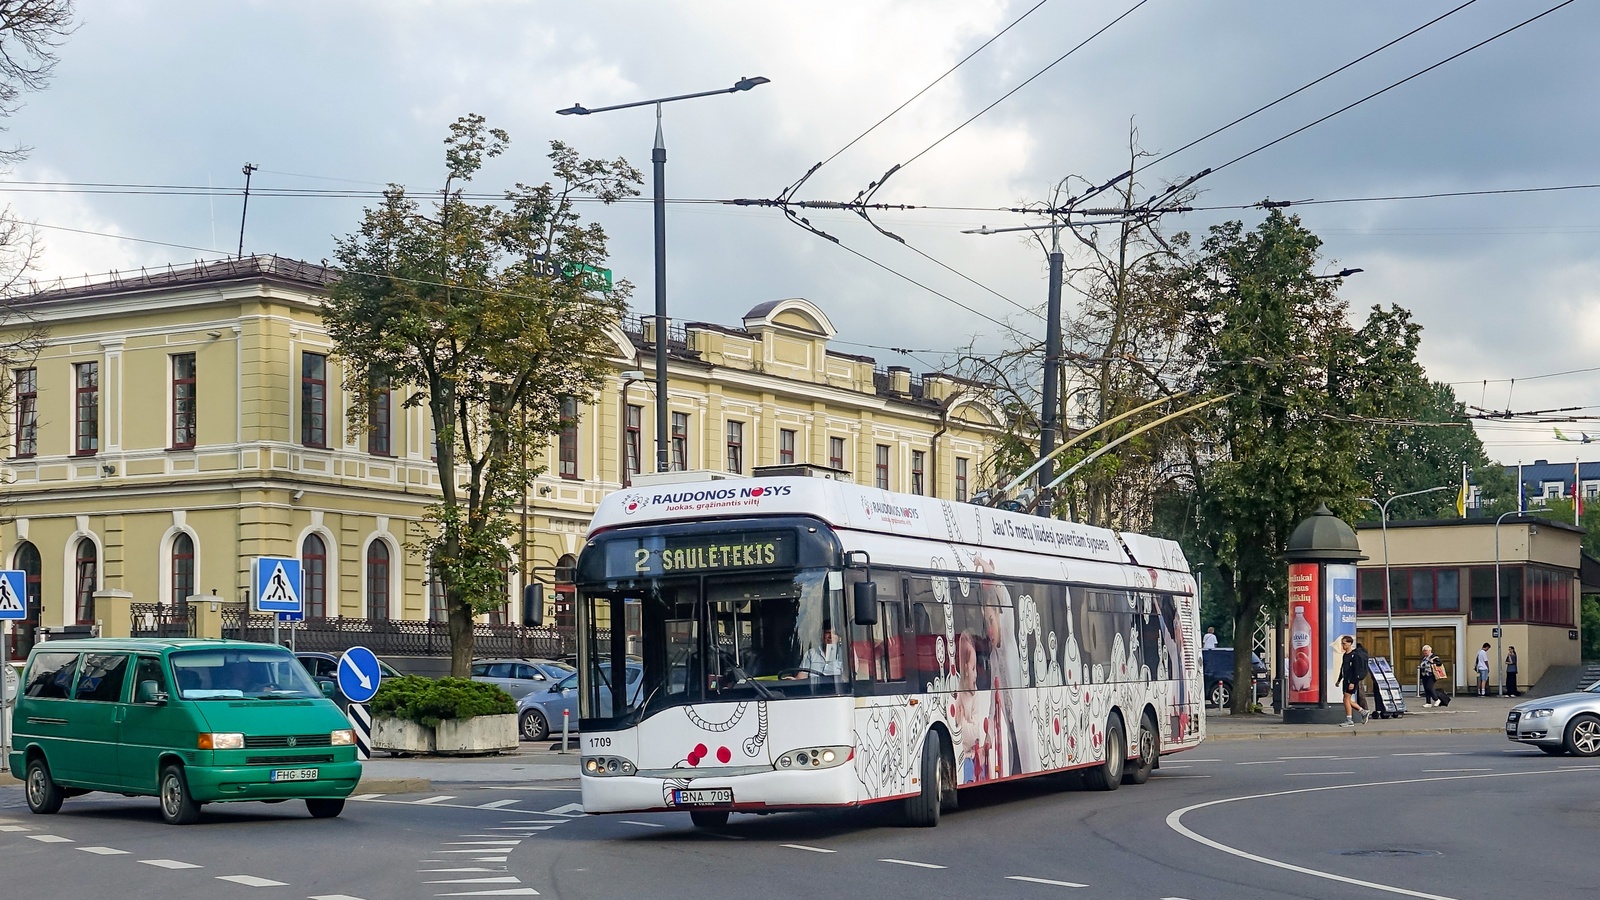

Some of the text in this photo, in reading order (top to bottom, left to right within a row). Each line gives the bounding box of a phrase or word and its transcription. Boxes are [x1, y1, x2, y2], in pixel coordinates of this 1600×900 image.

[652, 485, 792, 505] RAUDONOS NOSYS
[665, 498, 760, 512] Juokas, grąžinantis viltį
[991, 517, 1110, 554] Jau 15 metų liūdesį paverčiam šypsena
[634, 542, 775, 572] 2 SAULĖTEKIS
[589, 737, 612, 748] 1709
[276, 770, 316, 779] FHG 598
[681, 791, 730, 802] BNA 709
